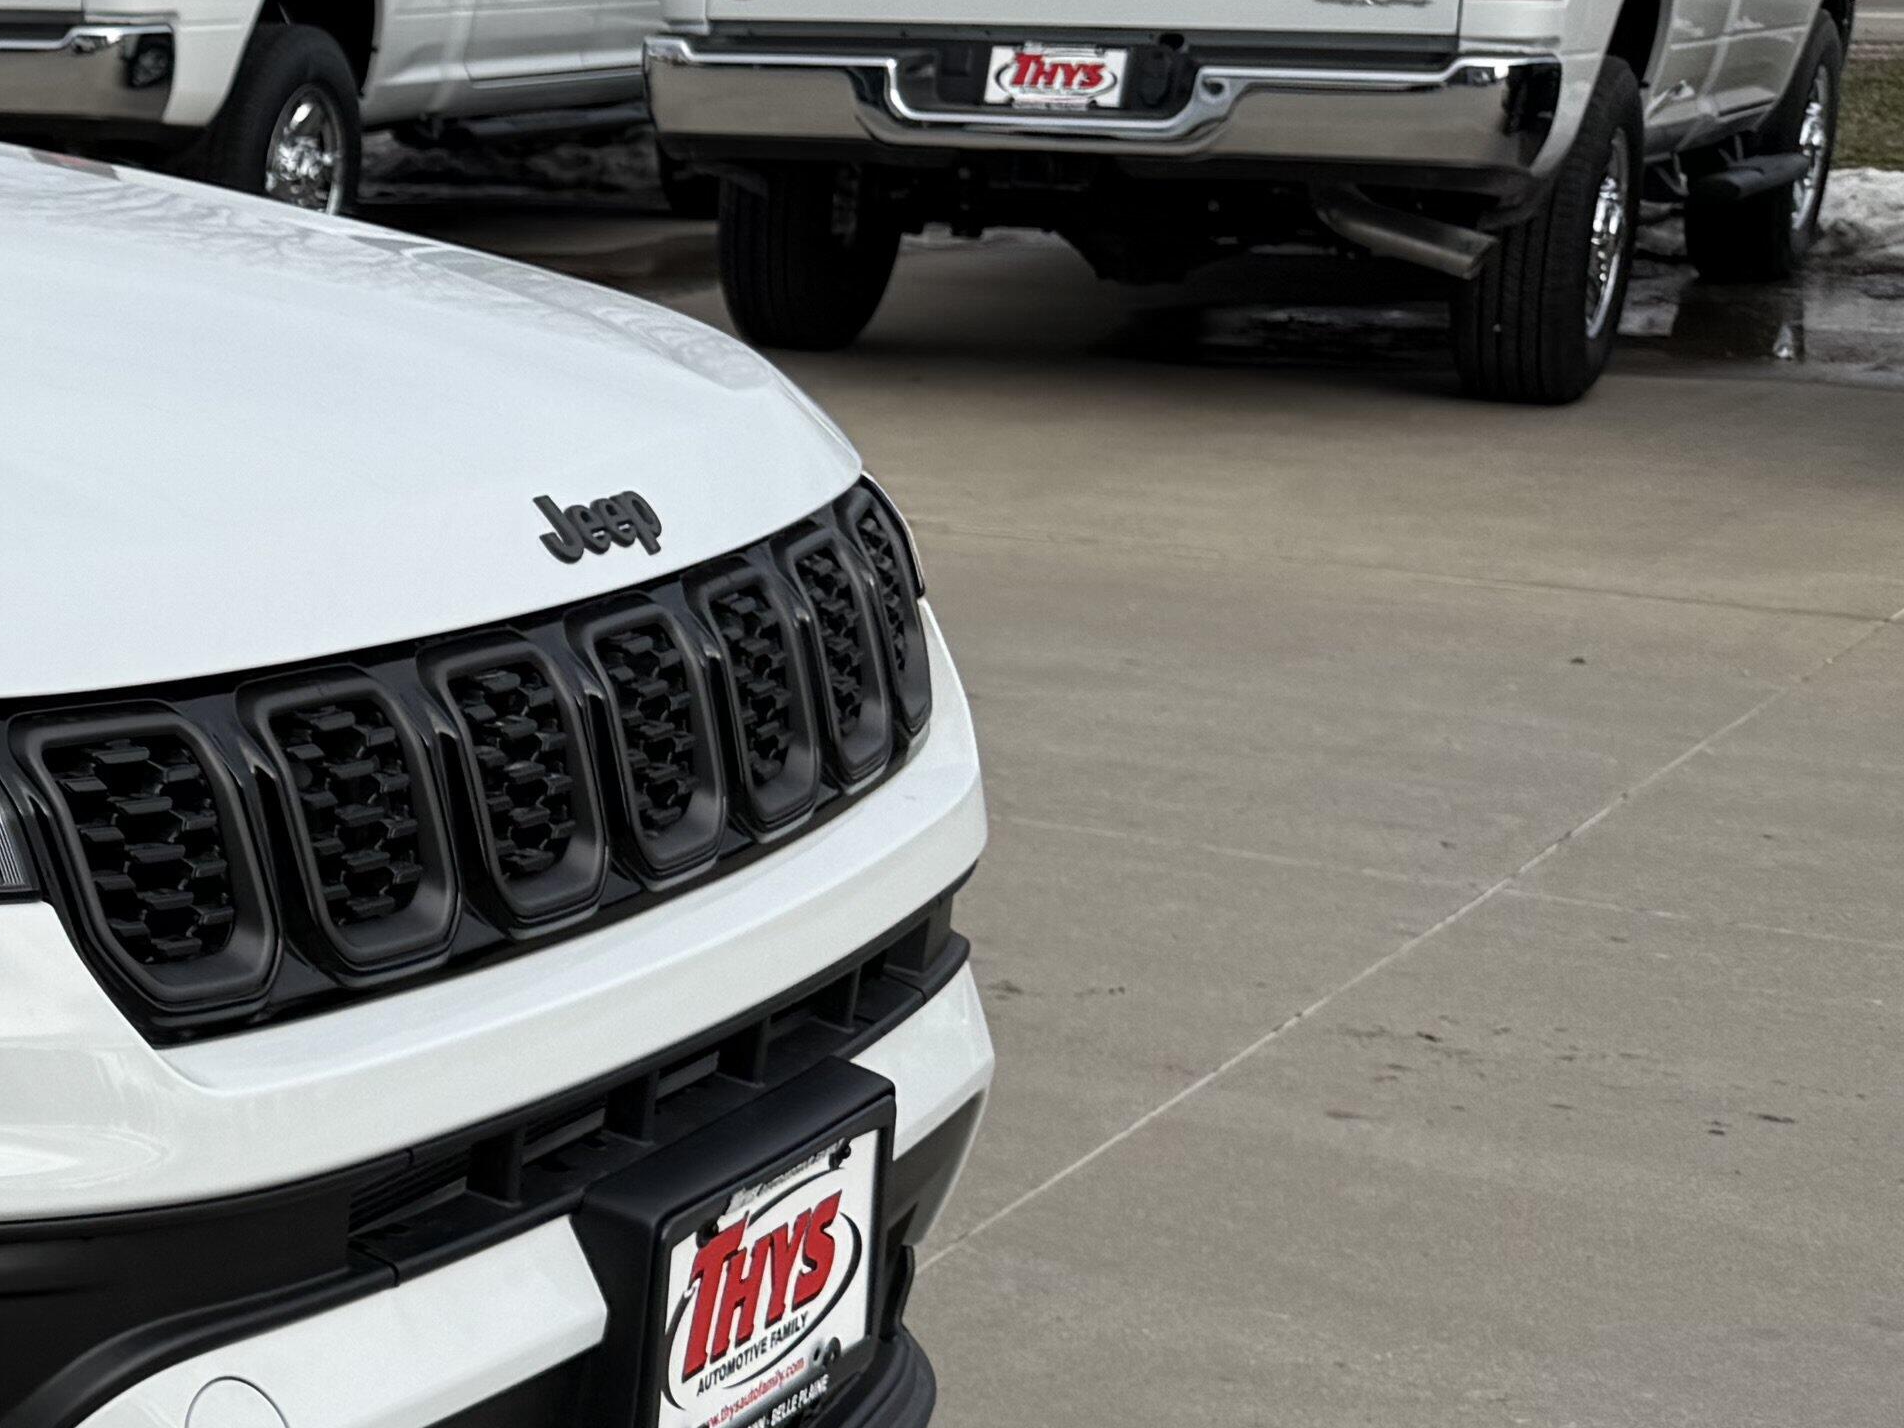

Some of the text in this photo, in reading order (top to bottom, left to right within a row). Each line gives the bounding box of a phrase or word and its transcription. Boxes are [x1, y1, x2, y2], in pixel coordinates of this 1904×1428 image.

[1010, 52, 1106, 90] THYS
[532, 490, 663, 565] Jeep
[681, 1188, 843, 1384] THYS
[696, 1313, 808, 1397] AUTOMOTIVE FAMILY
[770, 1392, 799, 1427] BELLE
[796, 1373, 830, 1408] PLAINE
